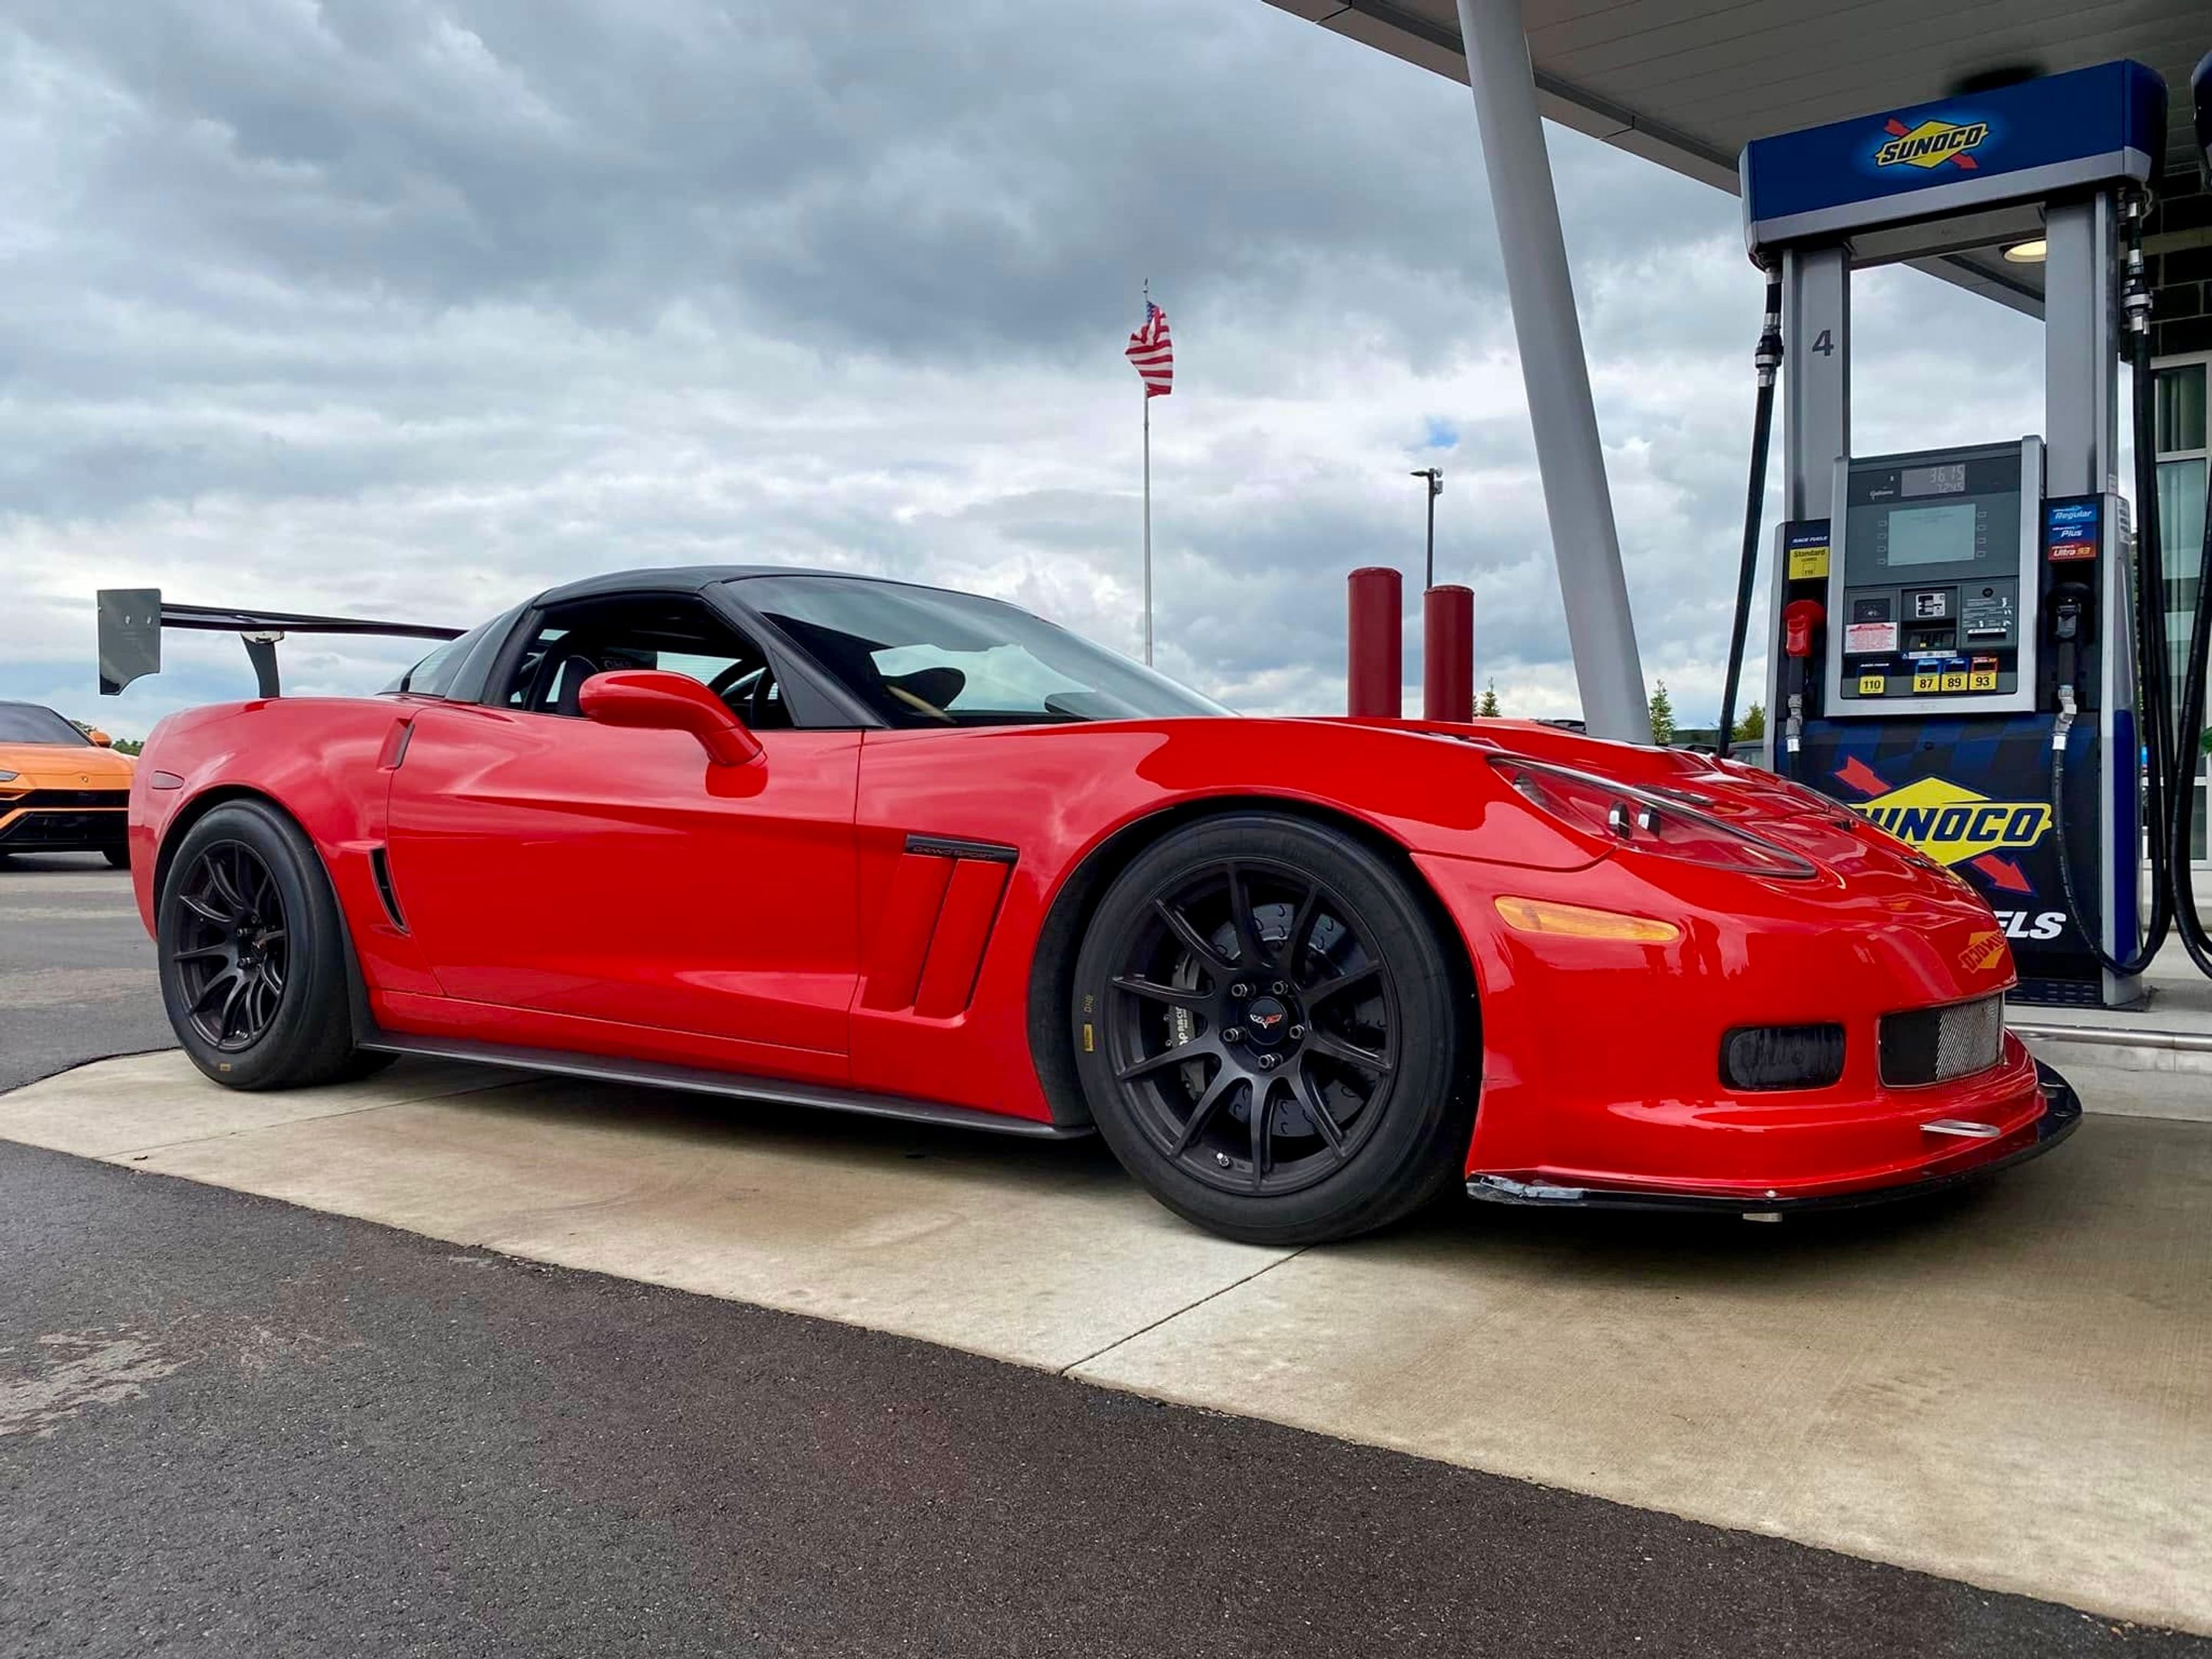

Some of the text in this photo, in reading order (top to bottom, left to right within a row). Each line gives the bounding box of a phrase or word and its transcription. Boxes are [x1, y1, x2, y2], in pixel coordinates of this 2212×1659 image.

[1881, 125, 1984, 163] SUNOCO
[1812, 329, 1834, 356] 4
[2055, 510, 2092, 520] Regular
[1793, 549, 1825, 558] Standard
[1863, 680, 1881, 689] 110
[1920, 679, 1933, 688] 87
[1948, 677, 1962, 687] 89
[1975, 677, 1990, 687] 93
[1854, 808, 2045, 842] UNOCO
[1993, 910, 2067, 939] ELS
